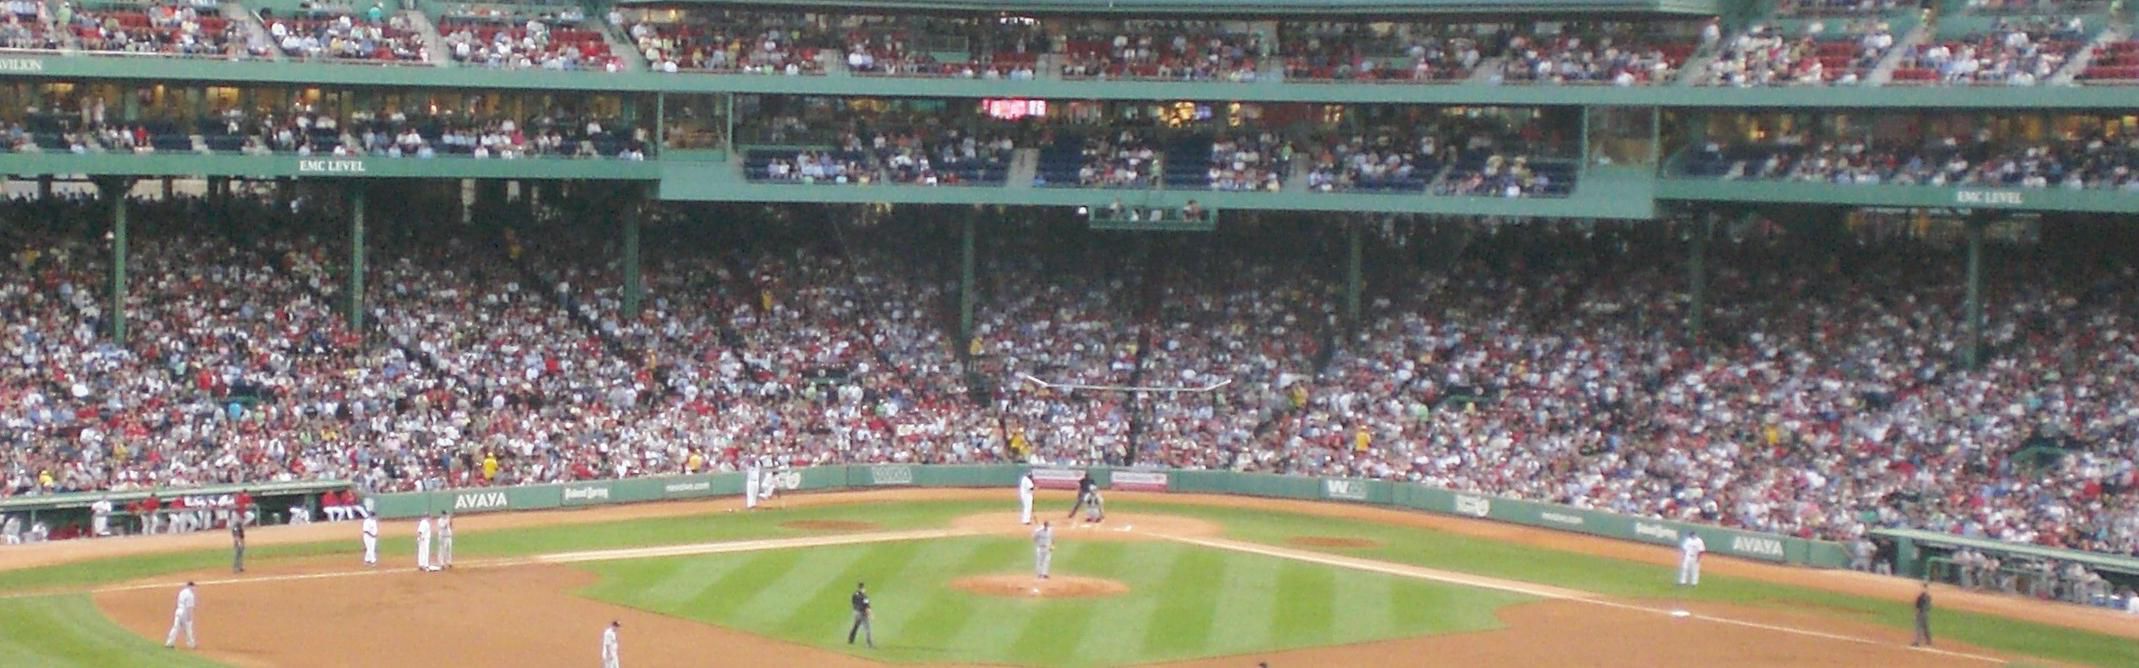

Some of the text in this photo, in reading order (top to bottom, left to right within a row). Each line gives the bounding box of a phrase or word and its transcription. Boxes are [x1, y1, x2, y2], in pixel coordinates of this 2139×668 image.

[299, 160, 365, 172] EMC LEVEL
[1957, 191, 2023, 204] EMC LEVEL
[454, 492, 507, 509] AVAYA
[1733, 536, 1784, 556] AVAYA
